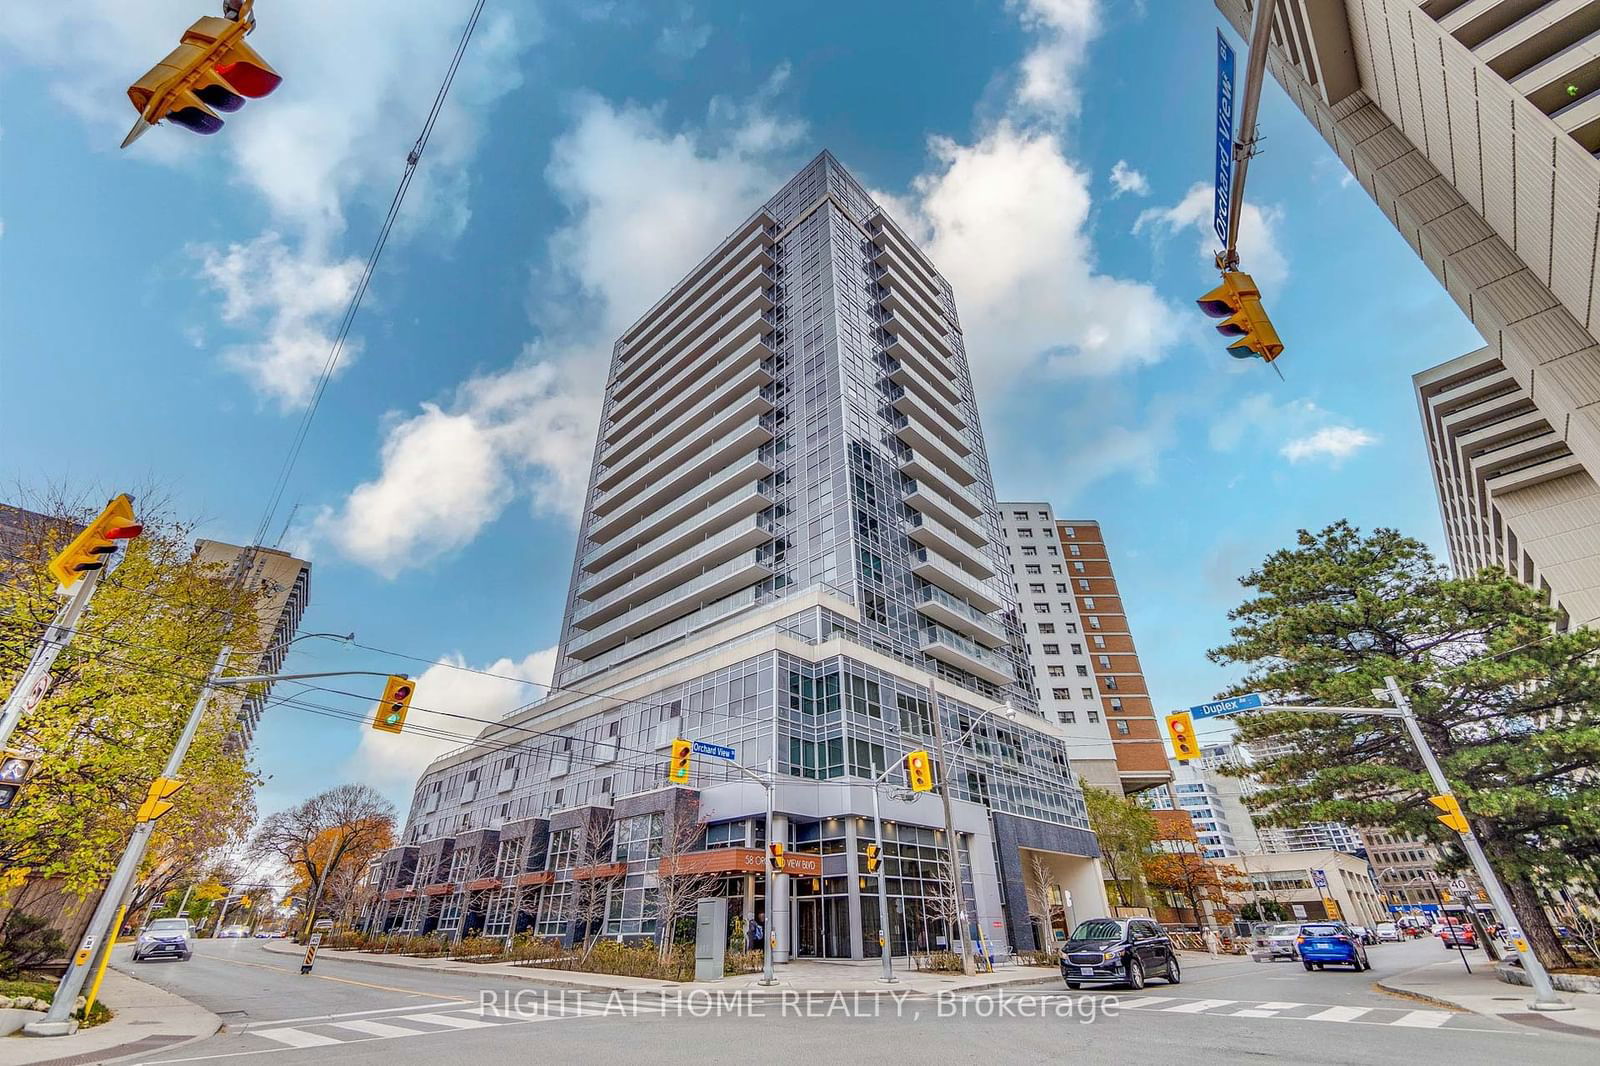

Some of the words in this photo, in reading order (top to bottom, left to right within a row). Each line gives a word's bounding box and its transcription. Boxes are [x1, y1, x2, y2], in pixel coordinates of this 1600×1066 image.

[1218, 71, 1233, 144] View
[1216, 140, 1230, 241] Orchard
[1202, 700, 1239, 714] Duplex
[694, 743, 717, 755] Orchard
[718, 748, 730, 757] View
[745, 855, 754, 865] 58
[787, 858, 801, 868] VIEW
[801, 860, 816, 870] BLVD
[1451, 879, 1467, 889] 40
